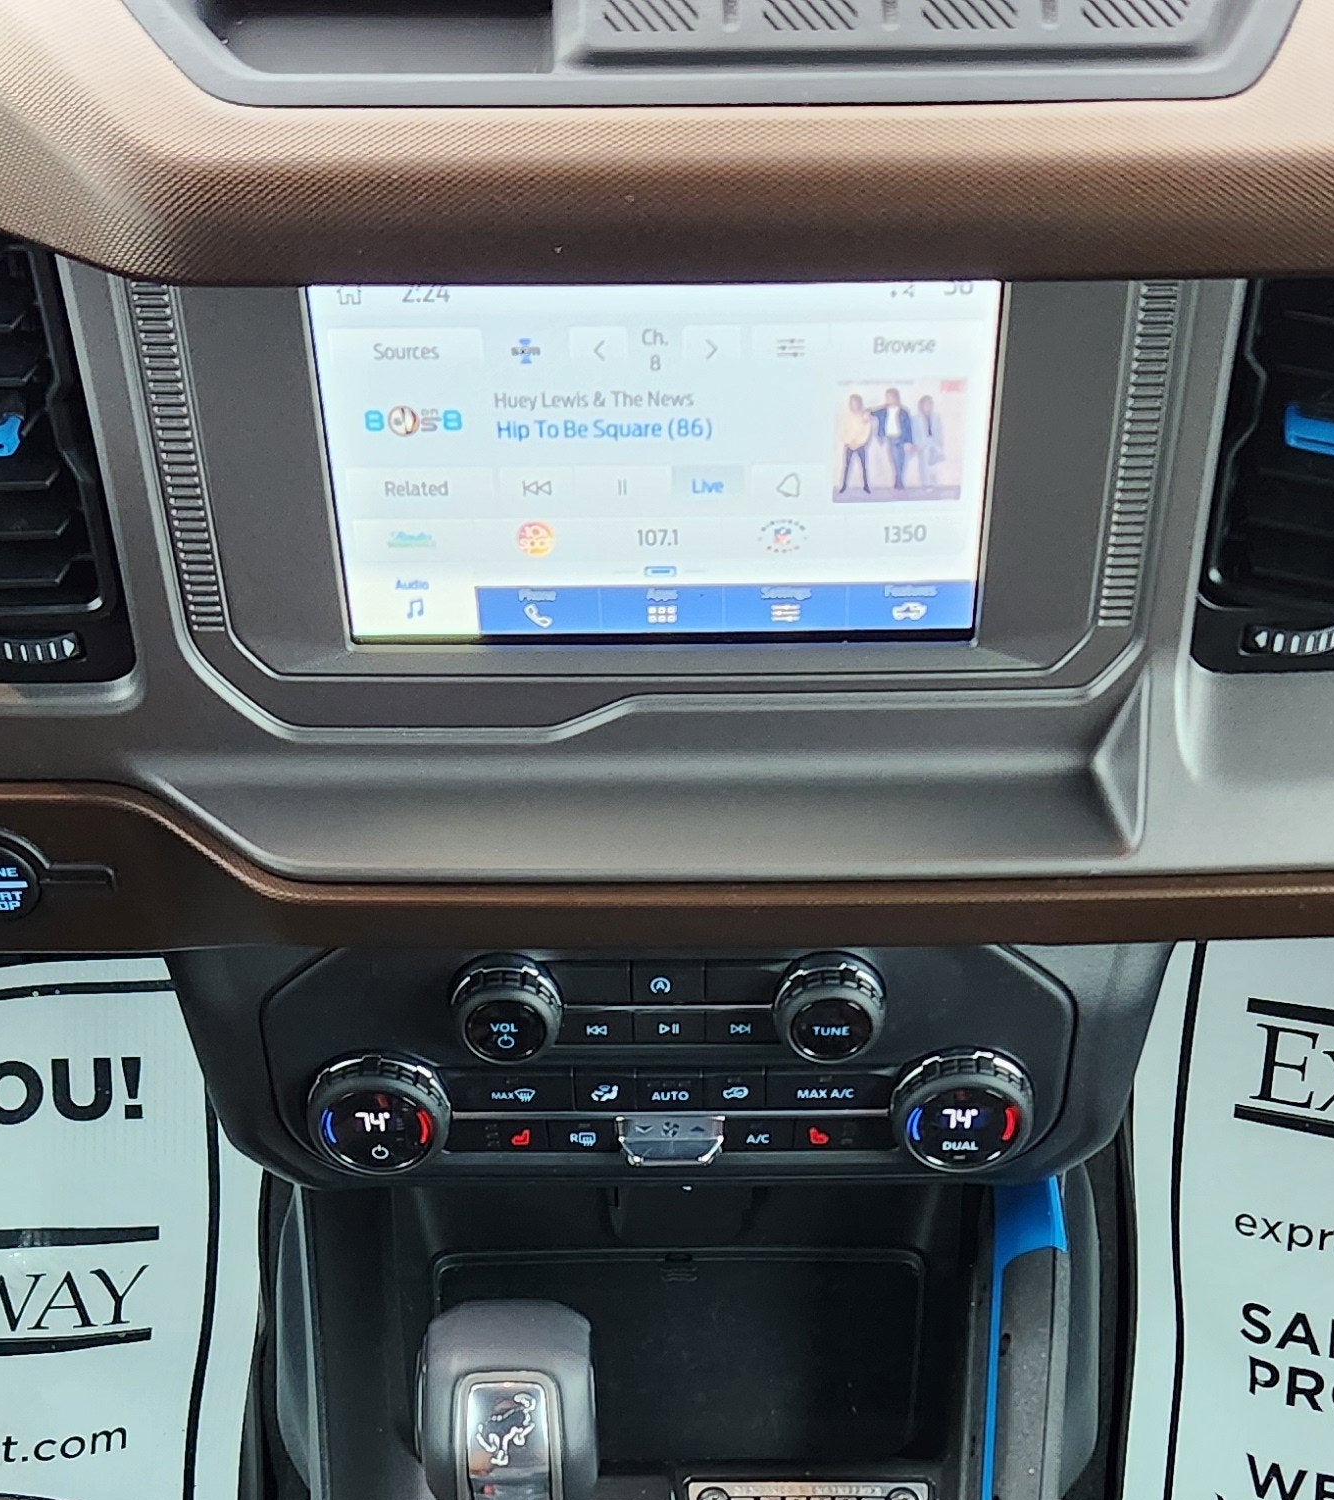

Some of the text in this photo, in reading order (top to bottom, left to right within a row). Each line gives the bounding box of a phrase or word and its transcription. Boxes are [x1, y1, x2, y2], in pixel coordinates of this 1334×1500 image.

[373, 344, 440, 360] Sources
[873, 336, 937, 354] Browse
[650, 355, 661, 372] 8
[494, 389, 695, 411] Huey Lewis & The News
[497, 417, 713, 442] Hip To Be Square (86)
[384, 480, 449, 497] Related
[692, 478, 724, 494] Live
[637, 529, 679, 546] 107.1
[884, 525, 927, 544] 1350
[395, 579, 430, 591] Audio
[490, 1022, 518, 1033] VOL
[812, 1025, 850, 1037] TUNE
[491, 1091, 514, 1100] MAX
[651, 1091, 689, 1101] AUTO
[796, 1088, 855, 1099] MAX A/C
[746, 1133, 770, 1144] A/C
[941, 1140, 979, 1151] DUAL
